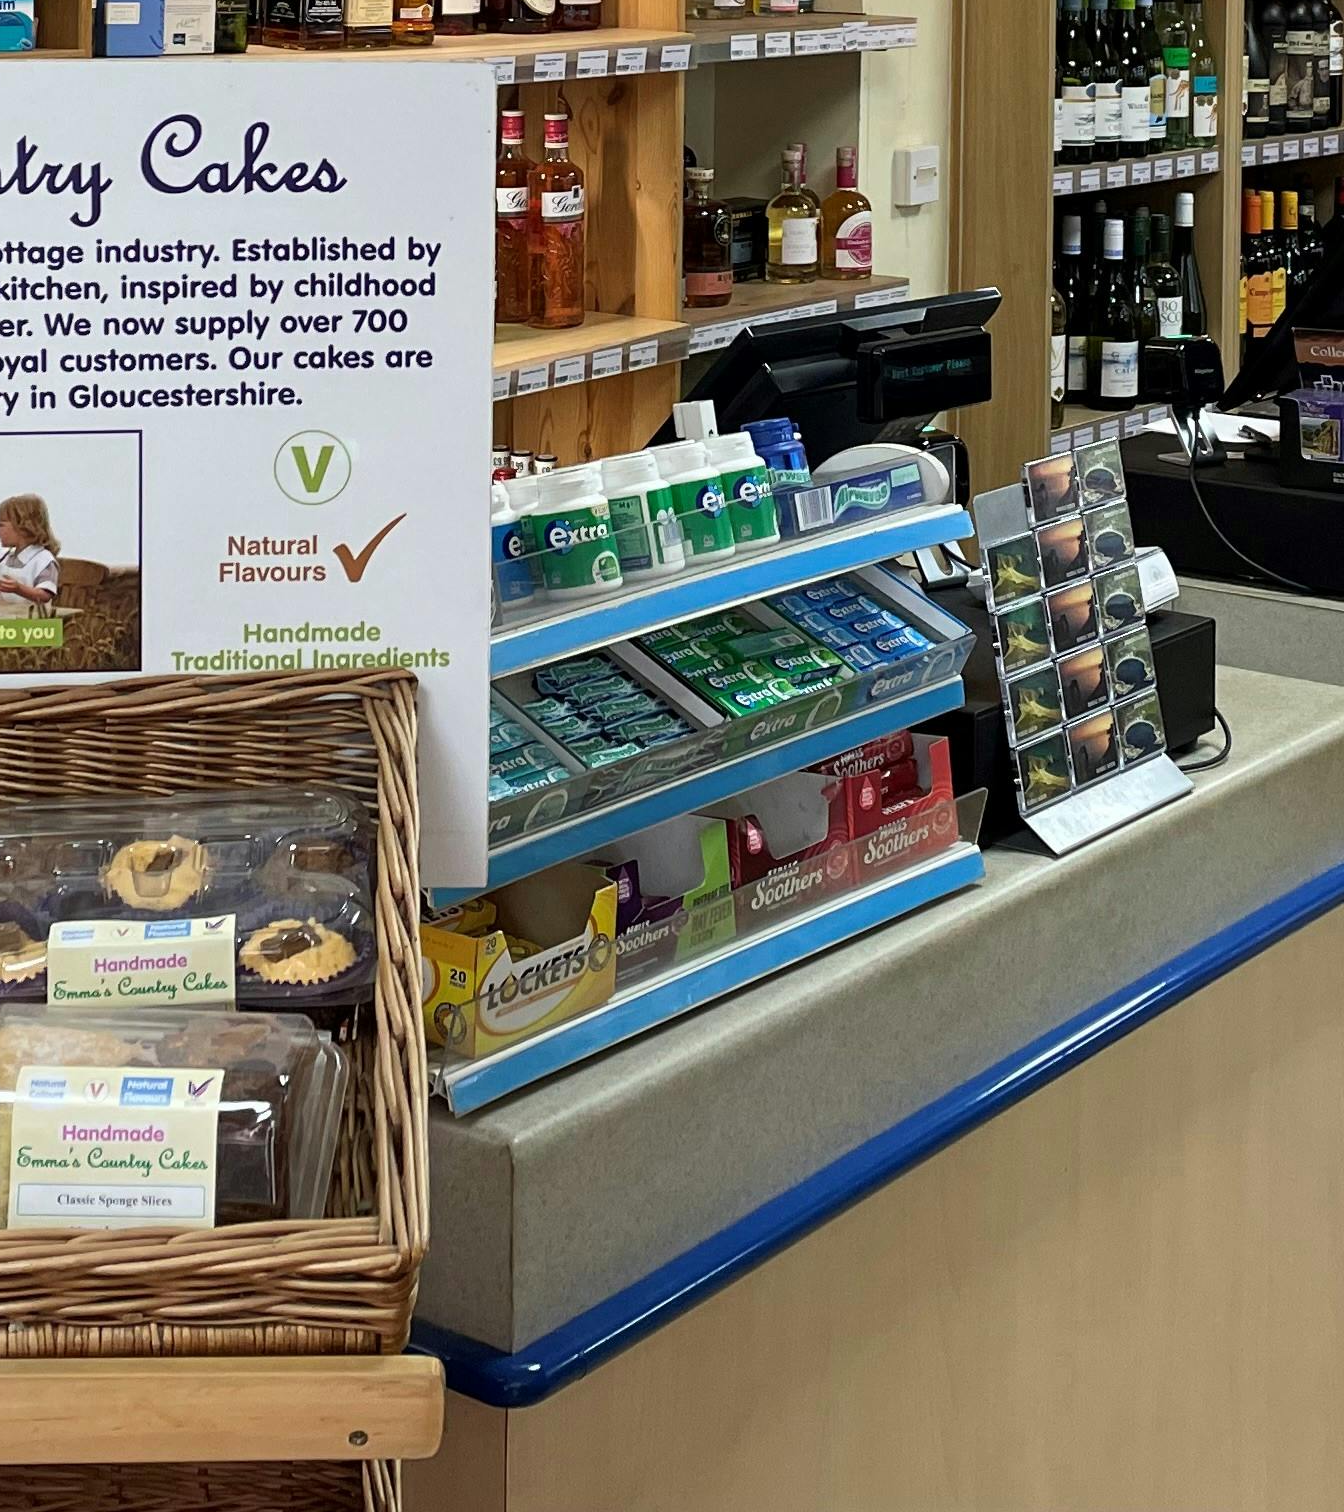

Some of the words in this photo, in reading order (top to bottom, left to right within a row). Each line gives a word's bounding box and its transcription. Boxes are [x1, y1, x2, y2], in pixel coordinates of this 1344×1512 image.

[139, 113, 348, 195] Cakes
[95, 238, 221, 270] industry.
[231, 236, 396, 264] Established
[407, 235, 442, 267] by
[120, 274, 238, 305] inspired
[250, 273, 284, 304] by
[293, 272, 437, 298] childhood
[43, 311, 92, 337] We
[102, 316, 164, 337] now
[174, 309, 270, 341] supply
[279, 314, 343, 334] over
[352, 308, 409, 334] 700
[59, 348, 218, 374] customers.
[228, 346, 284, 371] Our
[292, 343, 375, 370] cakes
[384, 348, 434, 369] are
[30, 384, 57, 410] in
[68, 381, 303, 409] Gloucestershire.
[227, 534, 319, 557] Natural
[548, 520, 608, 550] extra
[218, 560, 327, 584] Flavours
[20, 626, 56, 645] you
[242, 620, 381, 644] Handmade
[171, 647, 306, 671] Traditional
[311, 646, 450, 671] Ingredients
[750, 712, 797, 742] extra
[863, 820, 930, 865] Soothers
[750, 866, 824, 912] Soothers
[616, 925, 670, 956] Soothers
[449, 967, 467, 984] 20
[486, 944, 587, 1011] LOCKETS
[61, 1124, 166, 1144] Handmade
[16, 1145, 82, 1170] Emma's
[86, 1147, 154, 1178] Country
[158, 1146, 210, 1172] Cakes
[56, 1192, 95, 1207] Classic
[98, 1193, 138, 1210] Sponge
[141, 1192, 173, 1206] Slices
